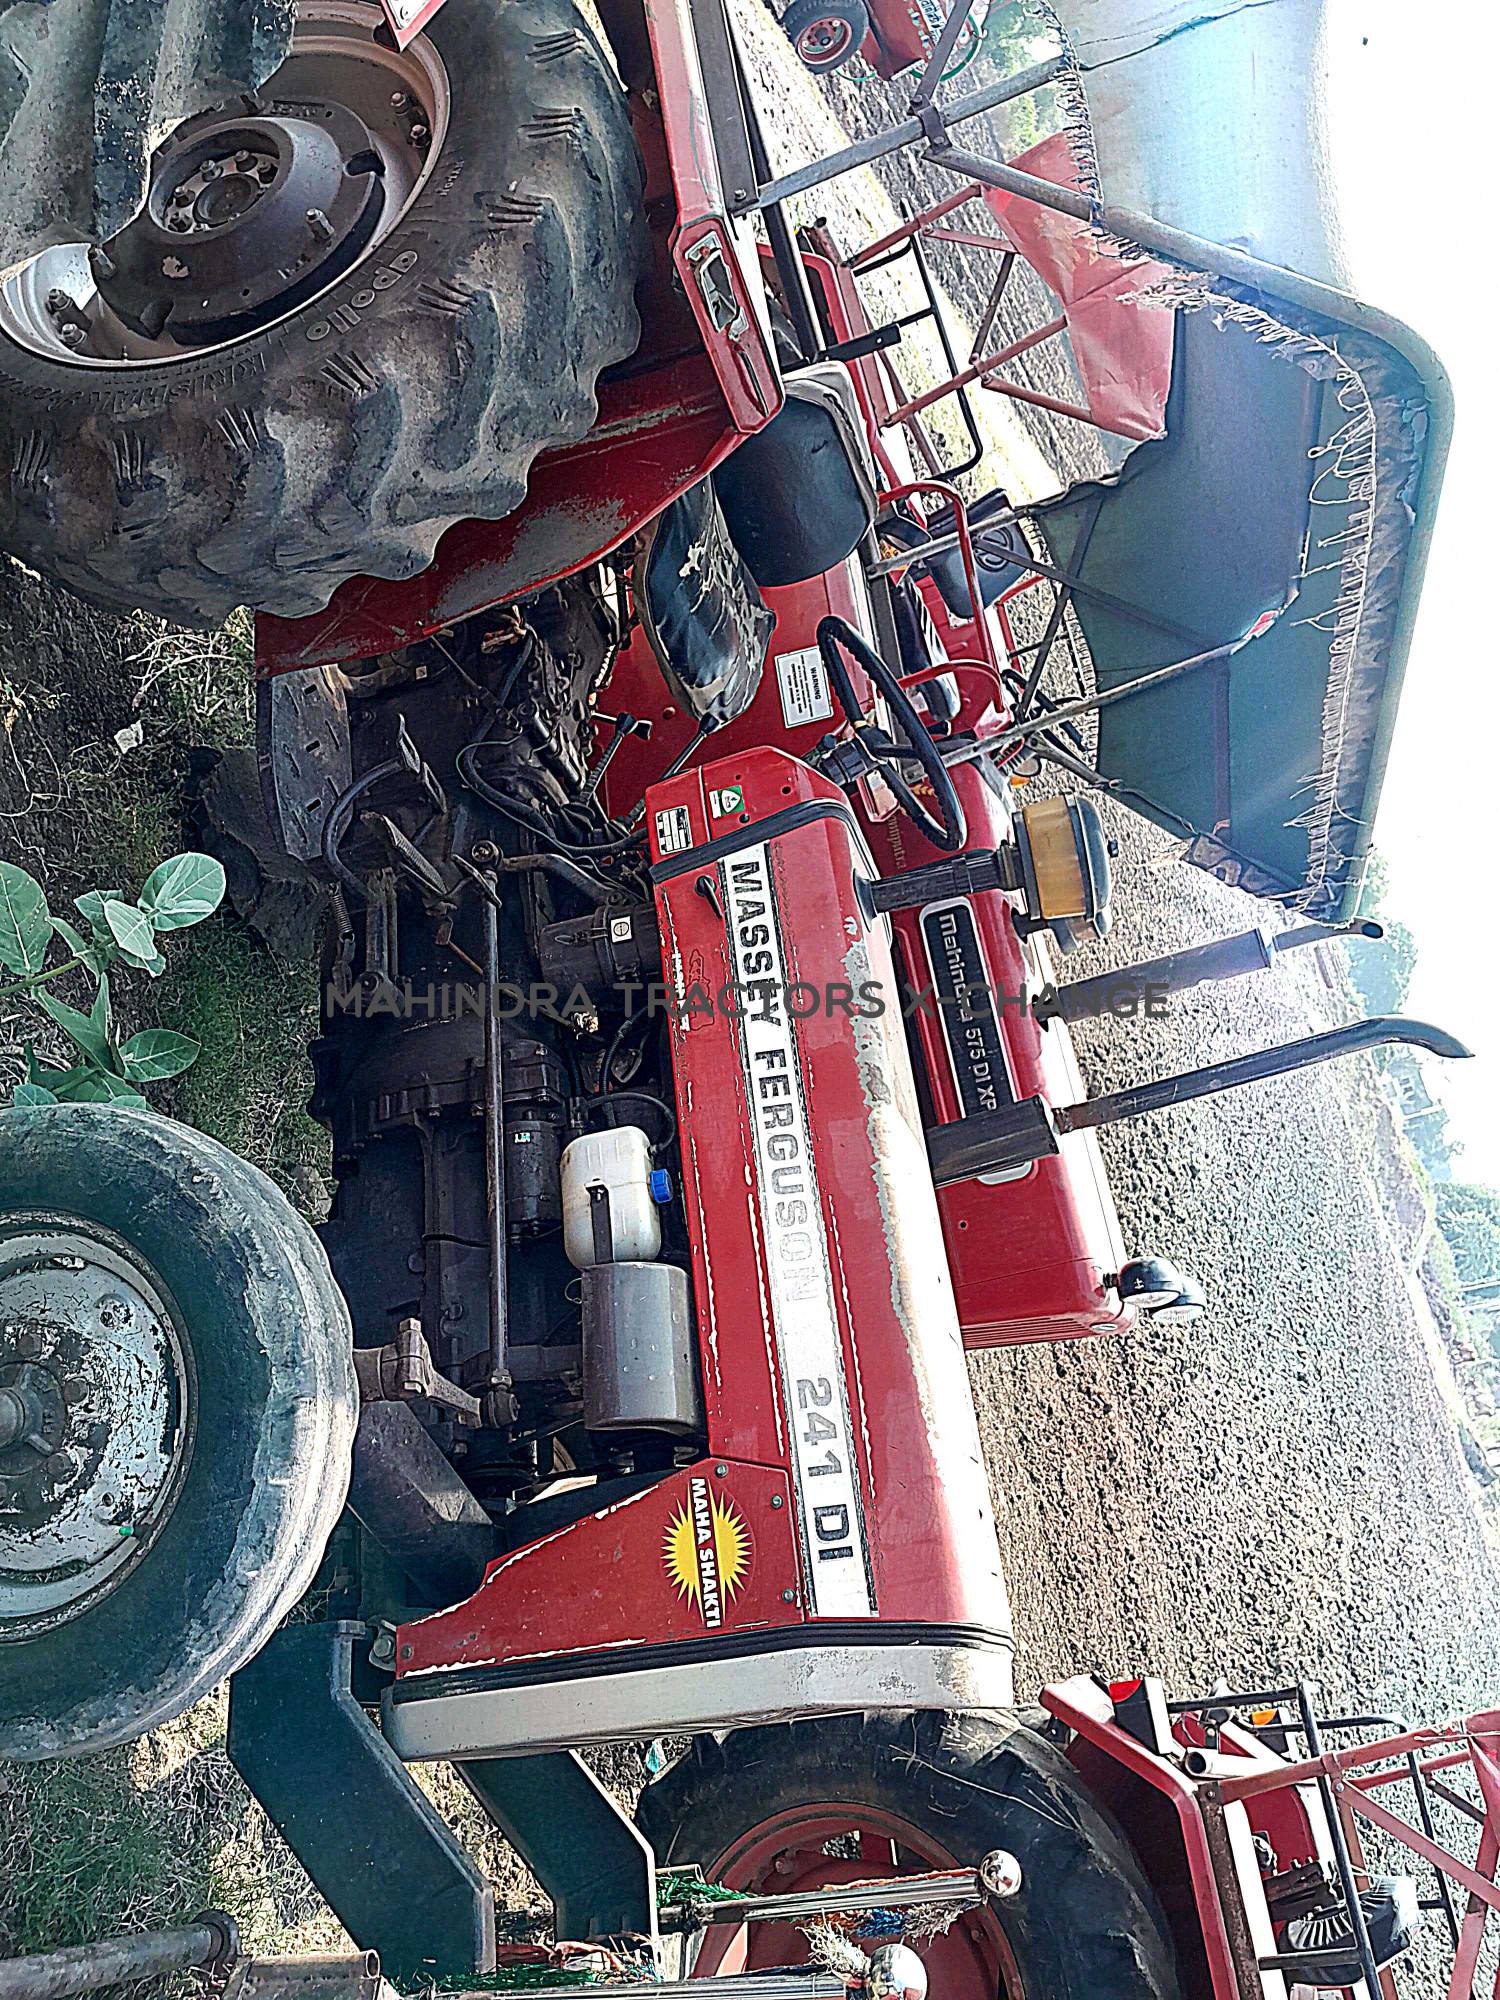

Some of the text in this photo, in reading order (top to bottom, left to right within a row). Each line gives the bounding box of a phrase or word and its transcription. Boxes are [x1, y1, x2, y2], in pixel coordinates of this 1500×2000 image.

[306, 250, 418, 341] apollo
[810, 667, 822, 700] WARNING
[964, 1028, 986, 1060] 575
[972, 1062, 990, 1083] DI
[731, 862, 854, 1562] MASSEY FERGUSON 241 DI
[691, 1478, 722, 1628] MAHA SHAKTI
